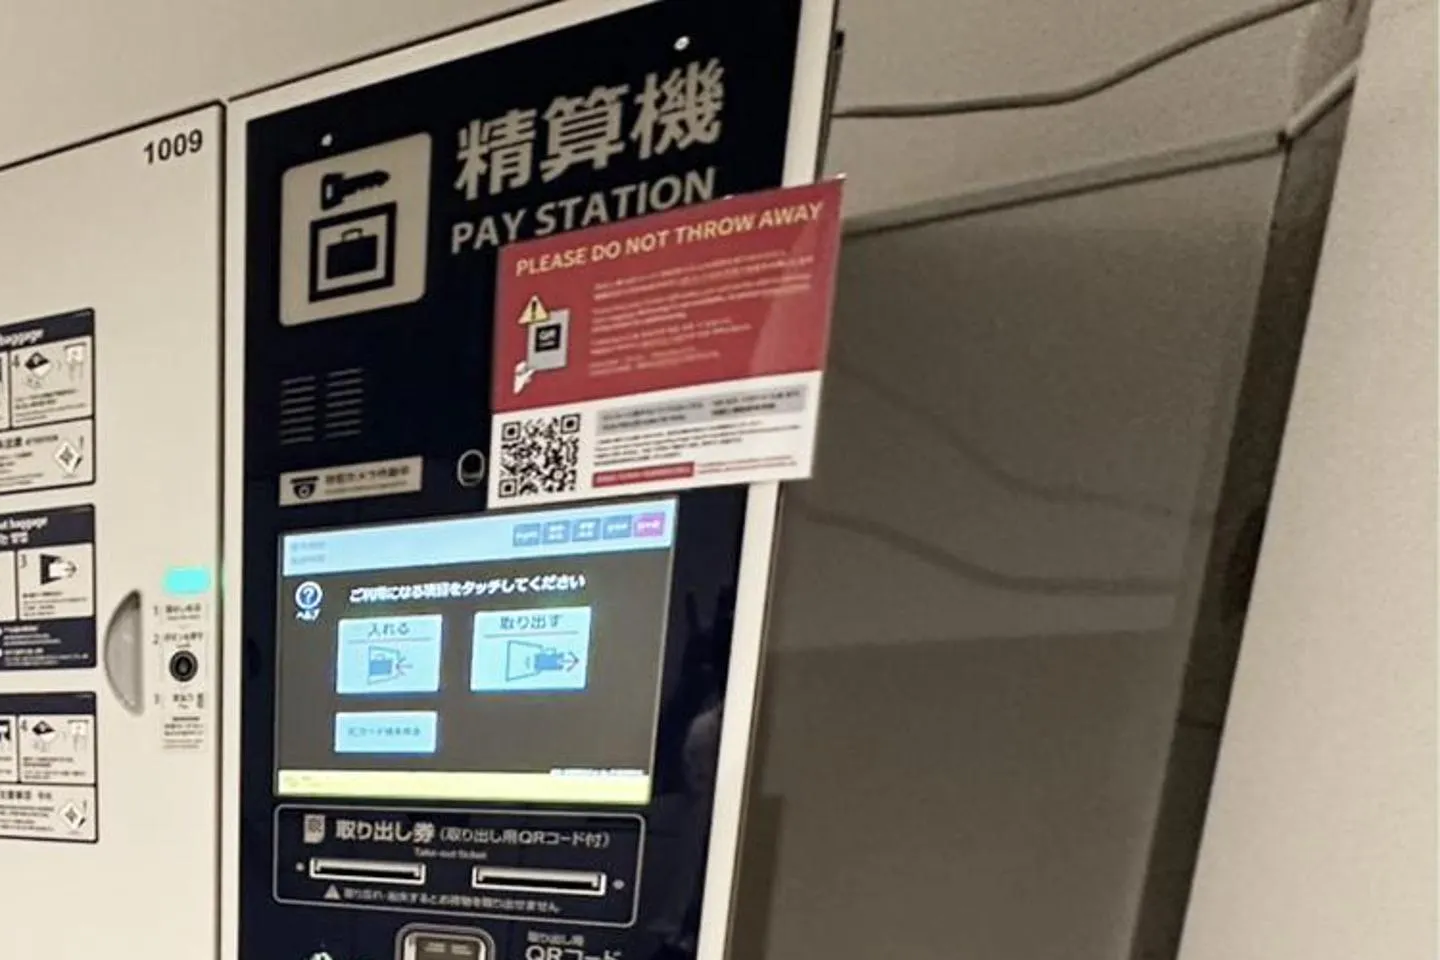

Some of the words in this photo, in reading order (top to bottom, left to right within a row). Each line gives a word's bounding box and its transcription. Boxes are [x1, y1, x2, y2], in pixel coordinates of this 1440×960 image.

[455, 57, 726, 200] 精算機
[142, 128, 205, 166] 1009
[449, 209, 529, 255] PAY
[534, 167, 716, 236] STATION
[515, 244, 586, 277] PLEASE
[590, 239, 620, 262] DO
[625, 226, 669, 256] NOT
[673, 213, 755, 247] THROW
[757, 201, 824, 231] AWAY
[9, 516, 48, 531] baggage
[368, 622, 410, 637] 入れる
[500, 613, 563, 631] 取り出す
[336, 819, 435, 844] 取り出し券
